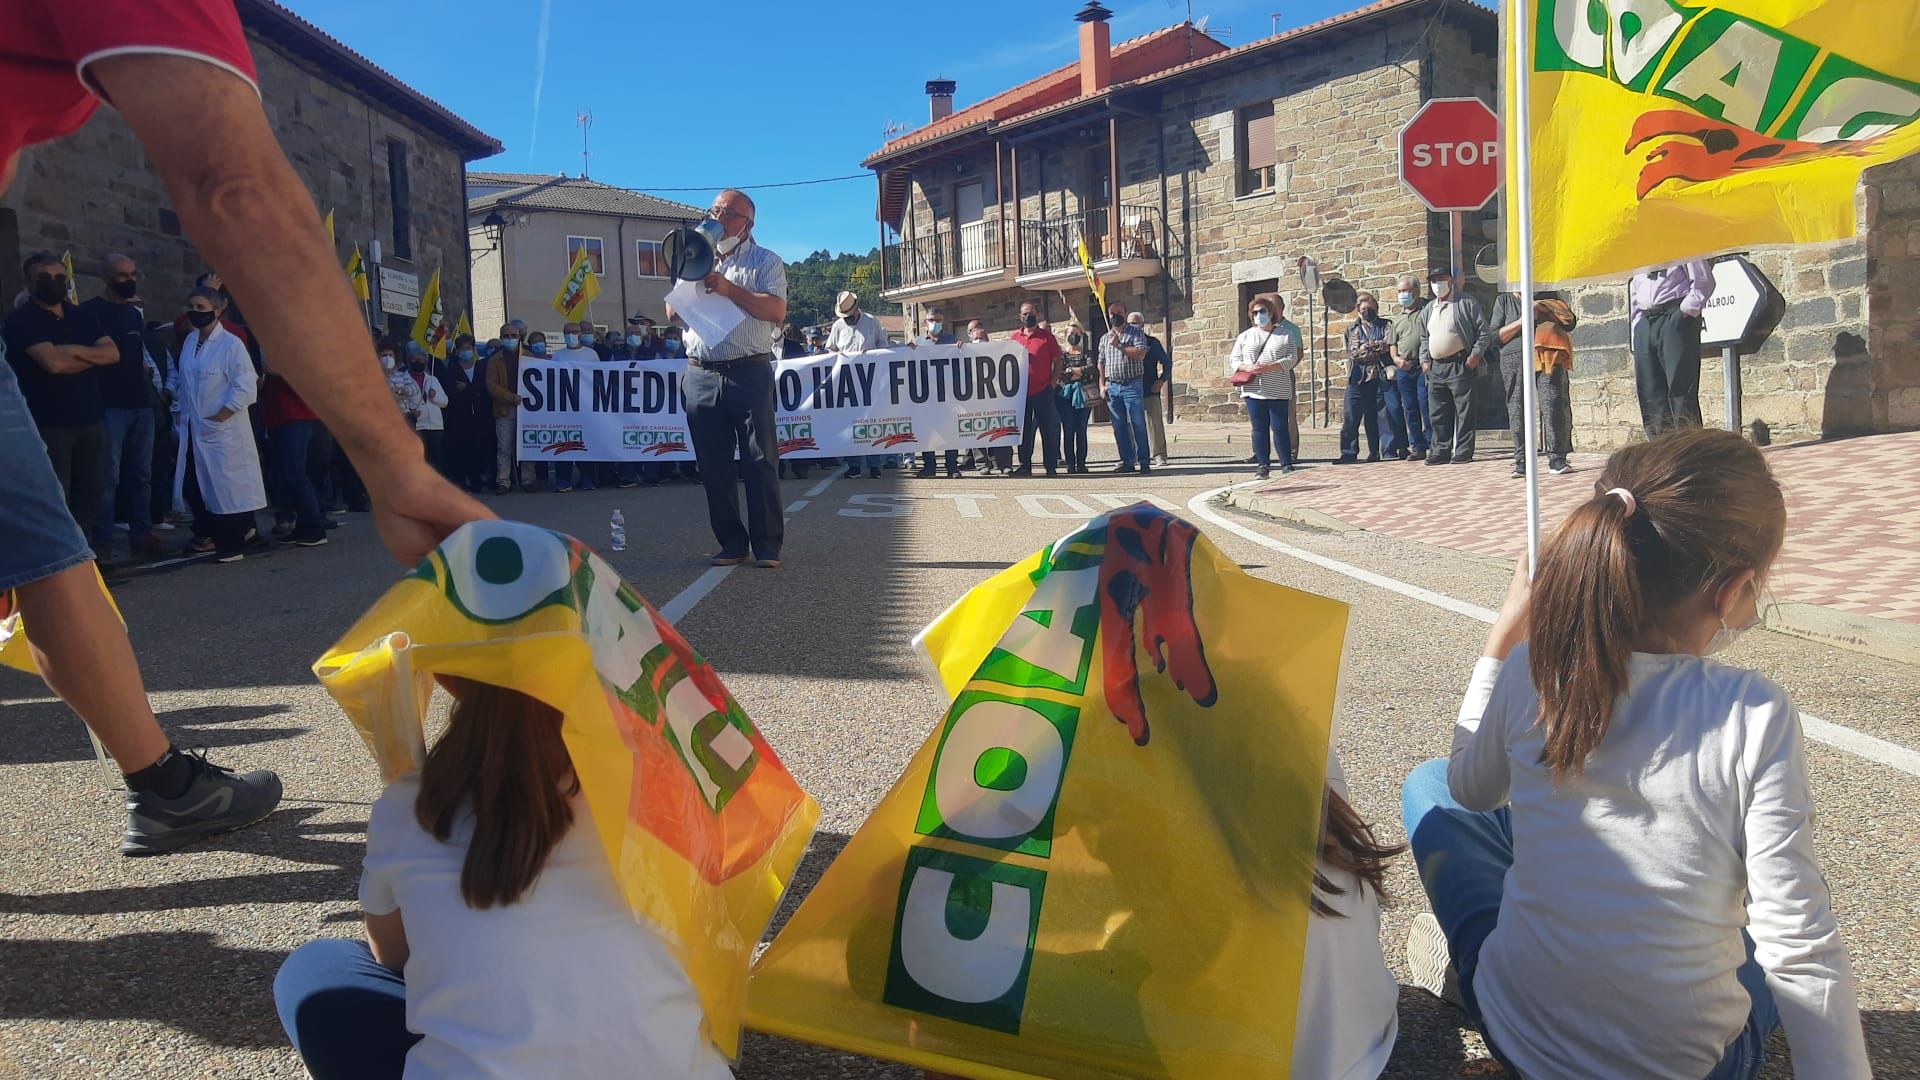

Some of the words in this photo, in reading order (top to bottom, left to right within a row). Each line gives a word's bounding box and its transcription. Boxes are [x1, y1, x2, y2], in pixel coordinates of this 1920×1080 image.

[1412, 141, 1498, 167] STOP
[1707, 295, 1735, 308] ALROJO
[522, 367, 580, 412] SIN
[592, 362, 688, 415] MÉDI
[774, 368, 801, 413] O
[812, 362, 876, 410] HAY
[889, 353, 1020, 405] FUTURO
[776, 414, 812, 423] MPESINOS
[958, 415, 1017, 433] COAG
[523, 430, 582, 444] COAG
[623, 431, 684, 445] COAG
[776, 422, 811, 440] AG
[853, 422, 912, 439] COAG
